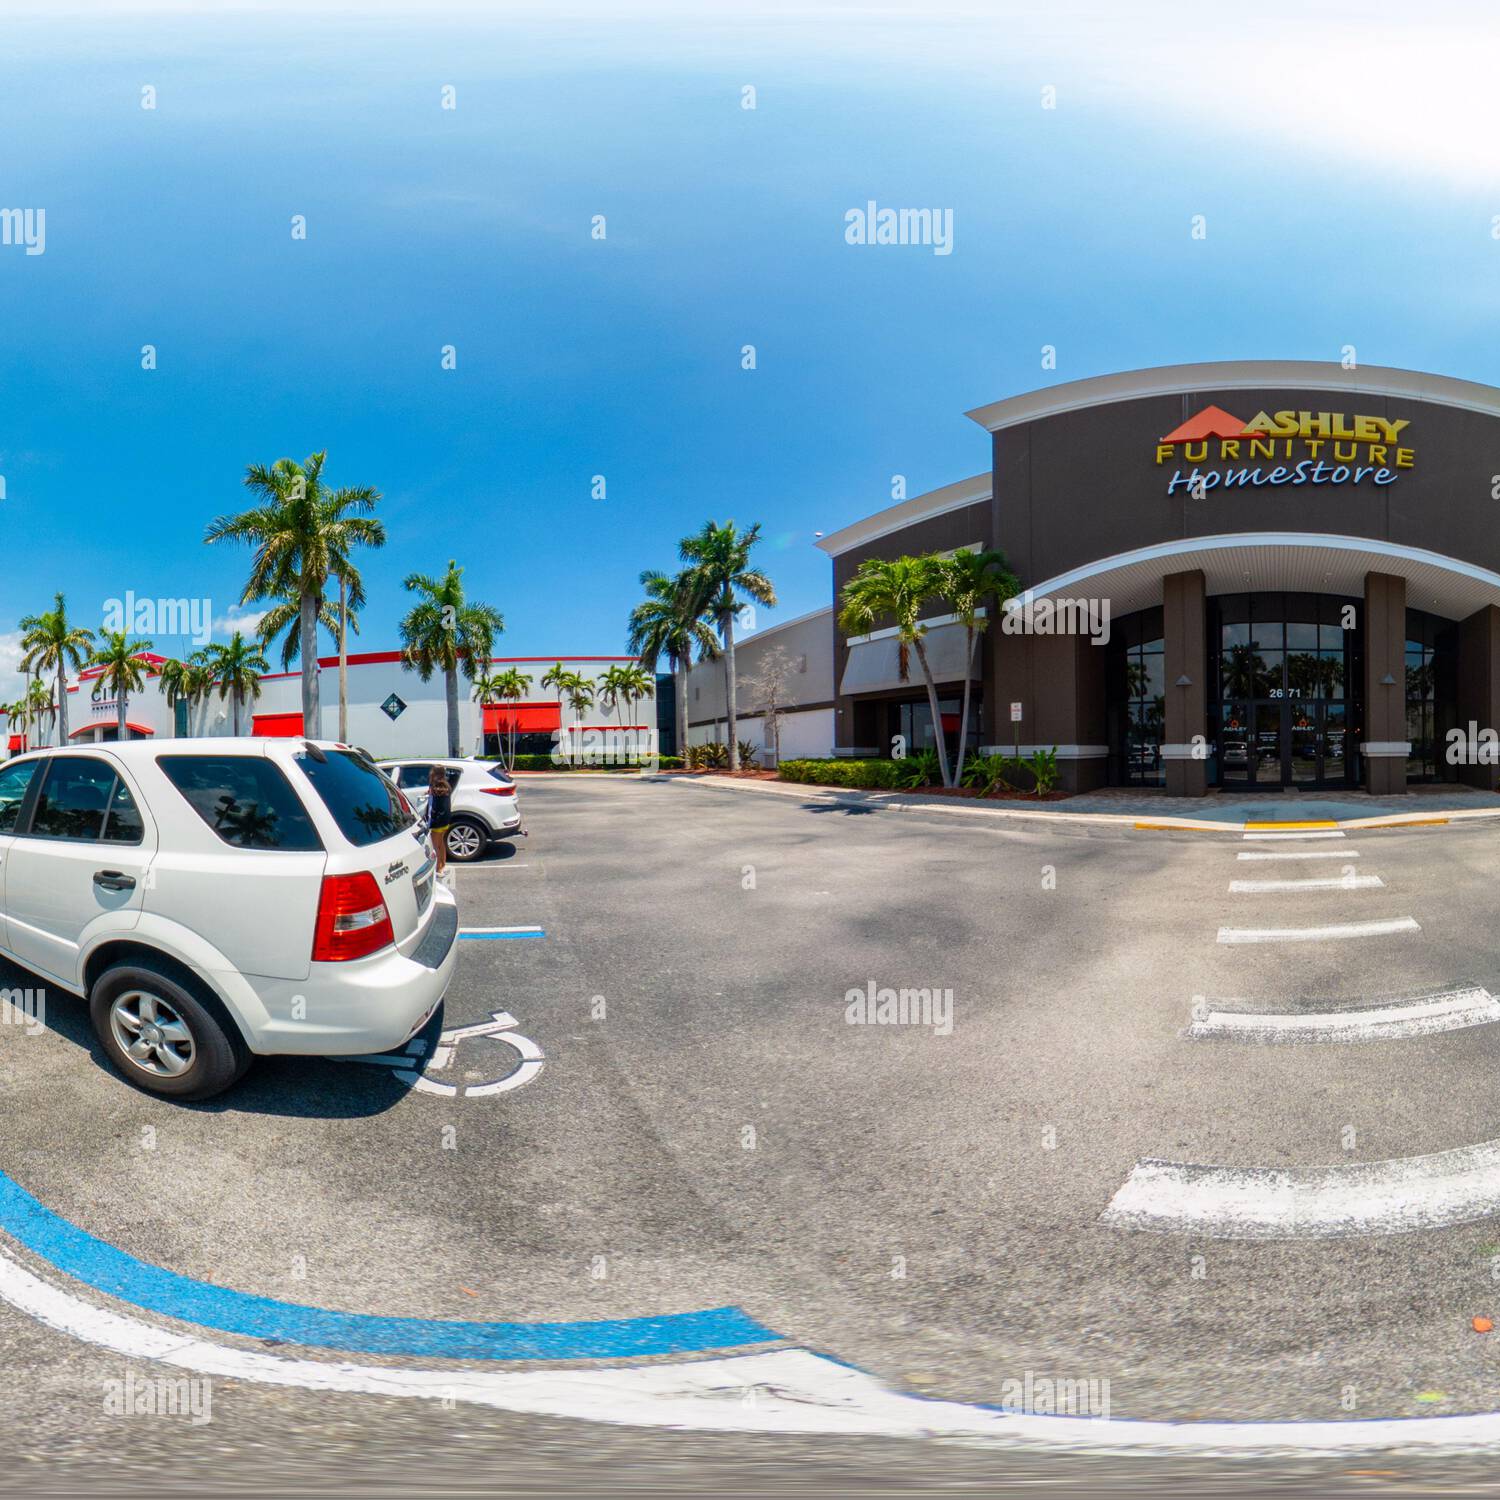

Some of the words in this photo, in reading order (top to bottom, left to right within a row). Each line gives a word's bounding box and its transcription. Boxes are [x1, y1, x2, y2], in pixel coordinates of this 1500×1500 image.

[1240, 410, 1411, 445] ASHLEY
[1156, 439, 1415, 468] FURNITURE
[1167, 460, 1399, 496] HomeStore
